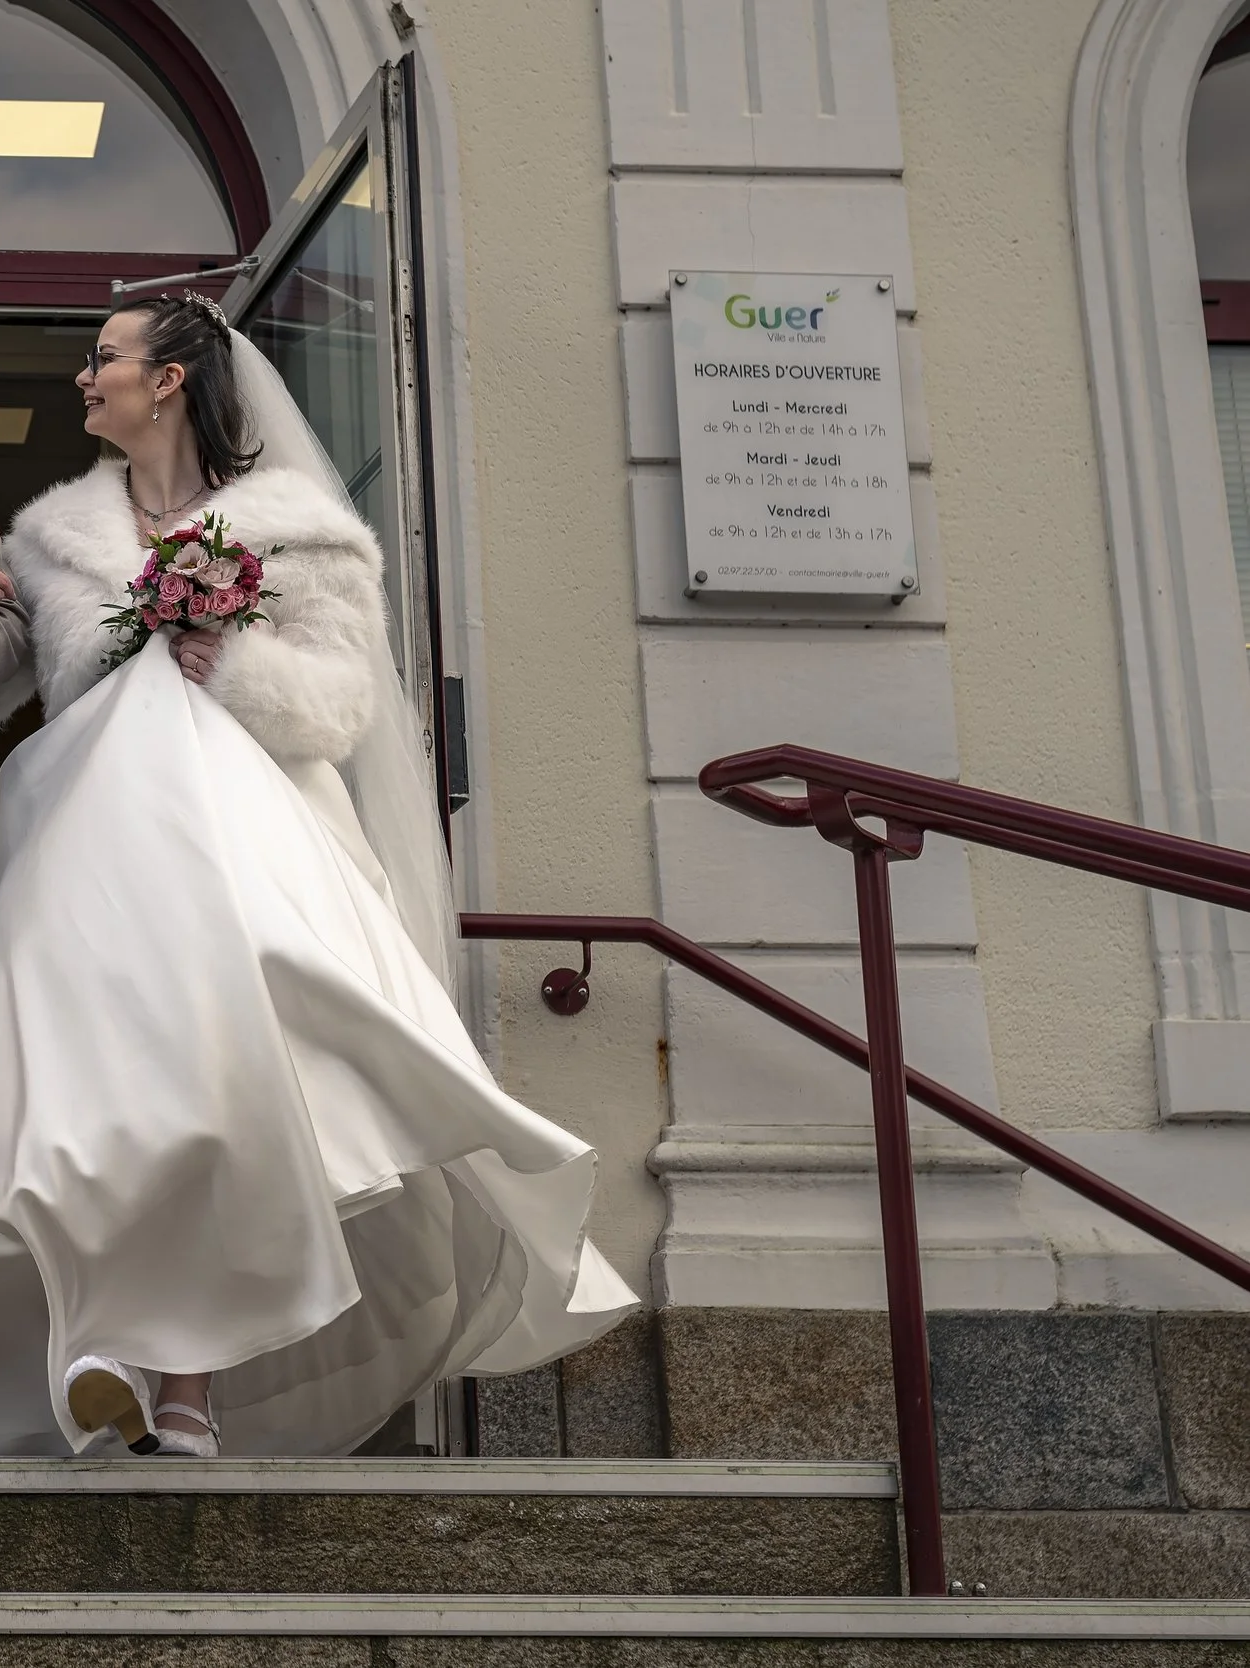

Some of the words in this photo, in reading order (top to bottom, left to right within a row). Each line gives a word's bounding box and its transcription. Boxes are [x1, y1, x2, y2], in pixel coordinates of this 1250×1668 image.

[724, 294, 824, 330] Guer
[767, 332, 786, 343] Ville
[796, 332, 826, 344] Nature
[694, 363, 770, 379] HORAIRES
[775, 365, 881, 381] D'OUVERTURE
[732, 400, 769, 413] Lundi
[785, 402, 848, 415] Mercredi
[703, 422, 718, 433] de
[724, 421, 739, 433] 9h
[743, 424, 752, 433] à
[759, 422, 780, 434] 12h
[785, 424, 796, 435] et
[800, 424, 815, 436] de
[822, 424, 844, 436] 14h
[864, 424, 886, 437] 17h
[746, 452, 788, 465] Mardi
[804, 453, 841, 466] Jeudi
[705, 474, 720, 485] de
[725, 473, 741, 485] 9h
[746, 476, 754, 485] à
[760, 474, 782, 486] 12h
[787, 476, 798, 486] et
[802, 477, 817, 487] de
[824, 476, 846, 488] 14h
[851, 478, 859, 488] à
[865, 476, 888, 489] 18h
[767, 504, 831, 518] Vendredi
[709, 527, 724, 538] de
[728, 525, 745, 538] 9h
[750, 528, 757, 538] à
[764, 526, 786, 539] 12h
[791, 528, 801, 539] et
[807, 529, 821, 540] de
[828, 528, 850, 540] 13h
[855, 530, 863, 541] à
[870, 528, 892, 541] 17h
